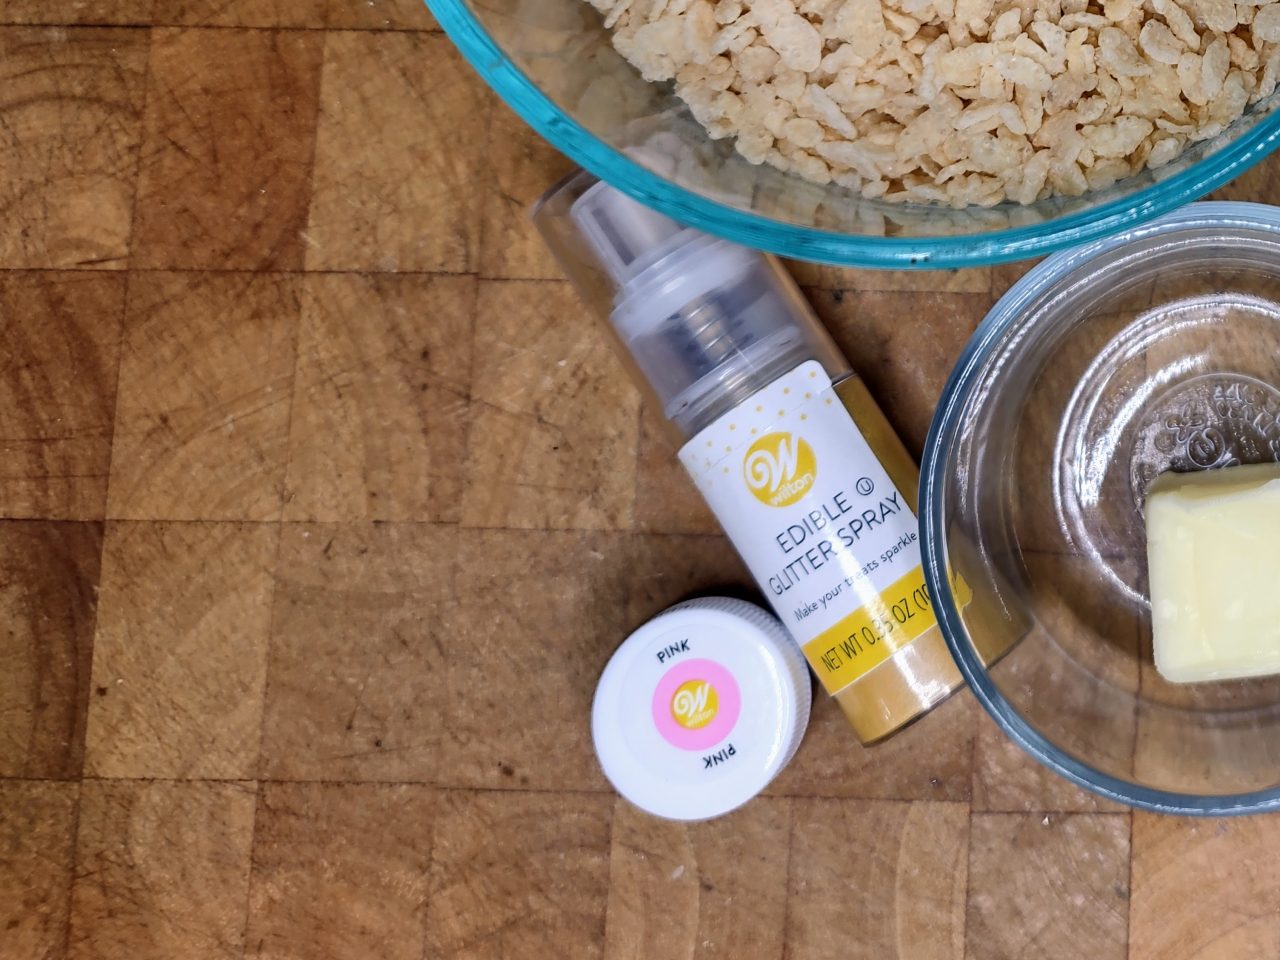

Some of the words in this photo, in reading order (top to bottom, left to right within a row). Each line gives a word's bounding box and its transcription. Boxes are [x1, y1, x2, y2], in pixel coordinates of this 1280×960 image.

[770, 472, 815, 506] wilton
[768, 540, 838, 596] GLITTER
[837, 491, 902, 548] SPRAY
[775, 491, 853, 554] EDIBLE
[793, 601, 819, 621] Make
[818, 583, 843, 611] your
[844, 559, 880, 588] treats
[880, 530, 918, 564] sparkle
[656, 638, 691, 664] PINK
[820, 646, 844, 673] NET
[838, 632, 864, 660] WT
[861, 610, 894, 646] 0.35
[892, 597, 916, 624] OZ
[702, 742, 737, 770] PINK
